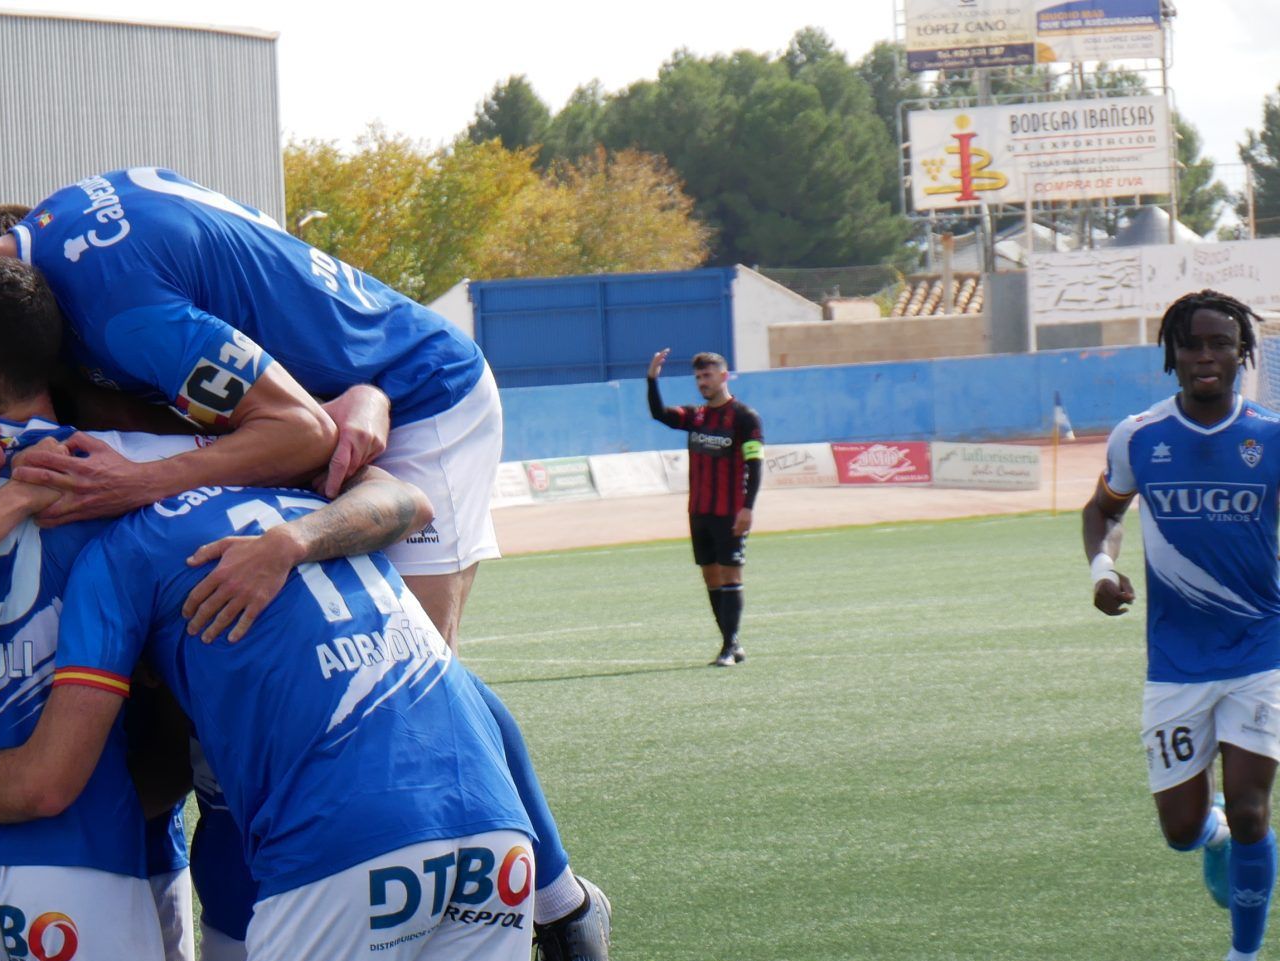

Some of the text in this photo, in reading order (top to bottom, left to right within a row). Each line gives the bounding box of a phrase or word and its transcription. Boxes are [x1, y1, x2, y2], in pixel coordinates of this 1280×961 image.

[964, 19, 1006, 34] CANO
[1040, 20, 1061, 29] QUE
[1062, 19, 1083, 28] UNA
[1009, 103, 1155, 135] BODEGAS IBAÑESAS
[1033, 174, 1144, 195] COMPRA DE UVA
[186, 364, 244, 416] C
[766, 450, 816, 473] PIZZA
[1152, 489, 1260, 513] YUGO
[1206, 513, 1253, 523] VINOS
[315, 628, 389, 681] ADRI
[1155, 726, 1196, 769] 16
[444, 905, 524, 930] REPSOL
